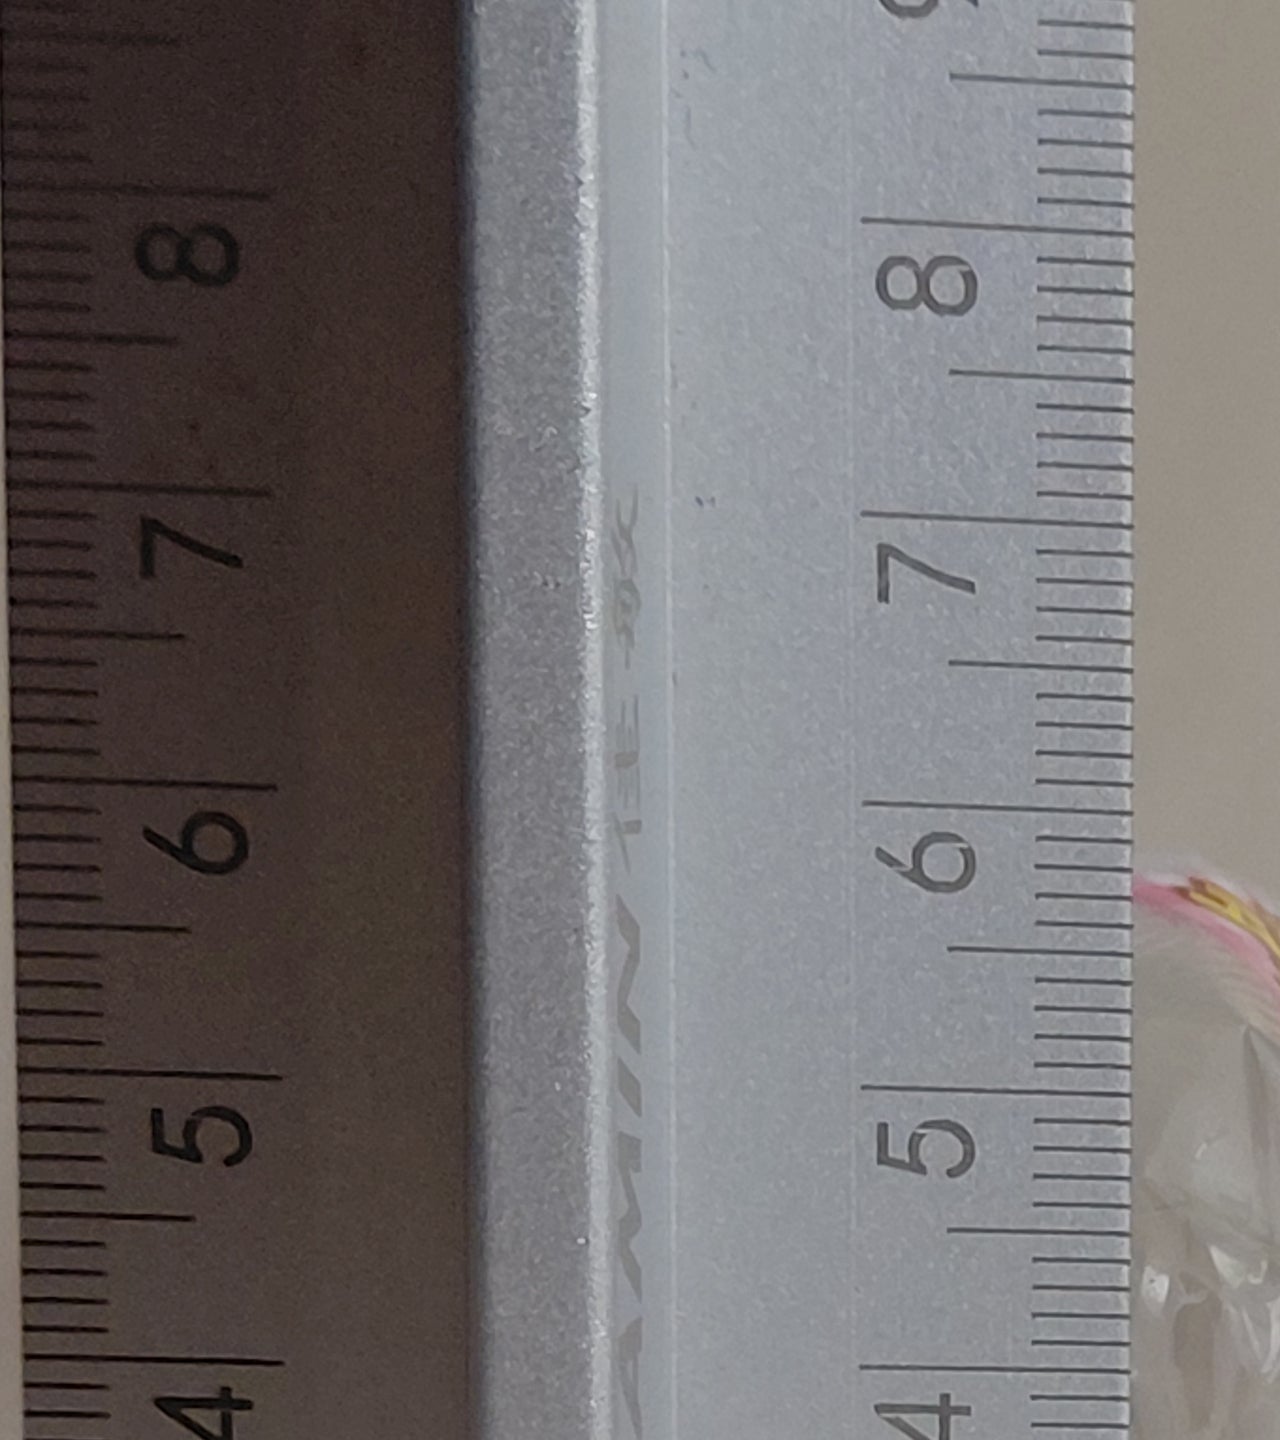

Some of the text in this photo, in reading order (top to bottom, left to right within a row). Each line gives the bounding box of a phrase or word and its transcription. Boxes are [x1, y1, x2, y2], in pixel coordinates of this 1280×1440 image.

[134, 223, 240, 287] 8
[875, 255, 978, 316] 8
[139, 516, 243, 579] 7
[876, 543, 976, 604] 7
[142, 811, 249, 876] 6
[875, 831, 977, 894] 6
[150, 1105, 253, 1168] 5
[876, 1119, 976, 1179] 5
